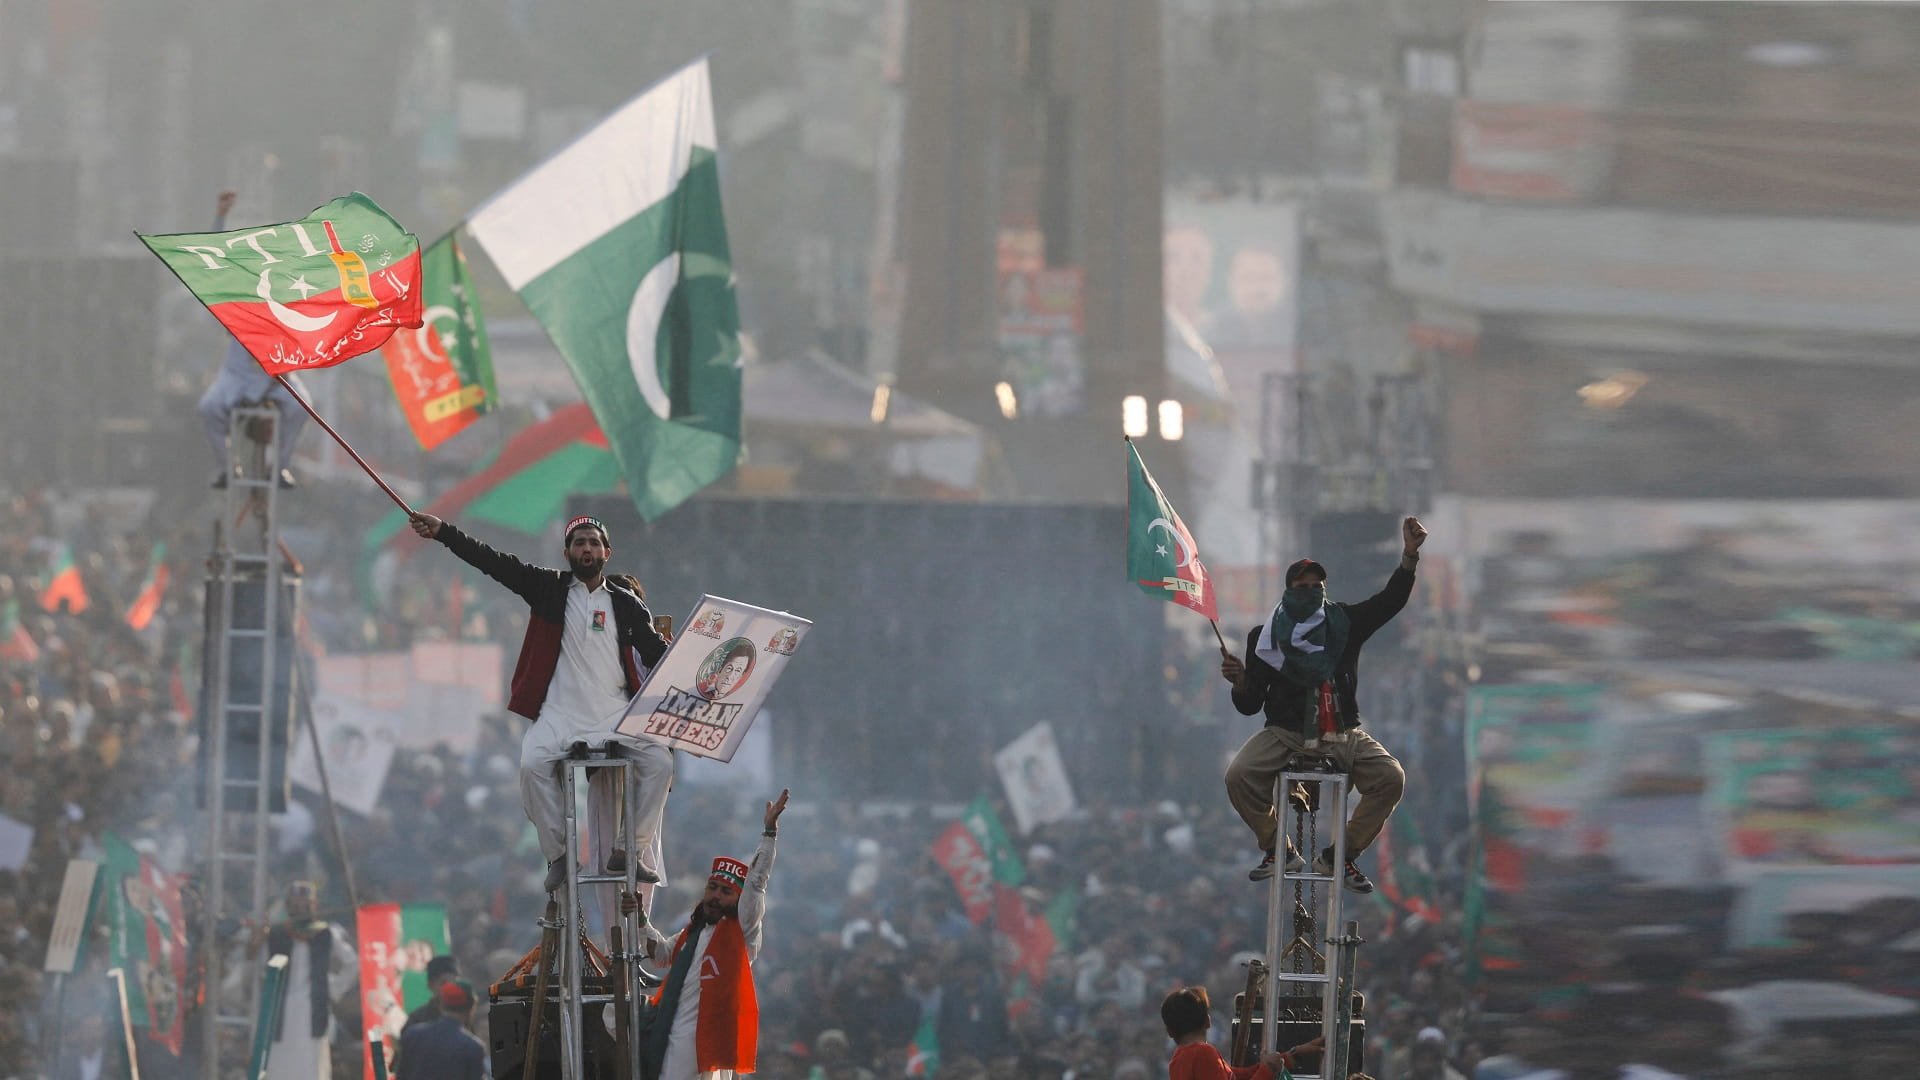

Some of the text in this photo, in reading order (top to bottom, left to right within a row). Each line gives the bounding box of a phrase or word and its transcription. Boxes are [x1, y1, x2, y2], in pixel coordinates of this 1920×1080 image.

[177, 223, 327, 270] PTI
[342, 260, 369, 299] PTI
[656, 685, 744, 730] IMRAN
[643, 711, 728, 751] TIGERS
